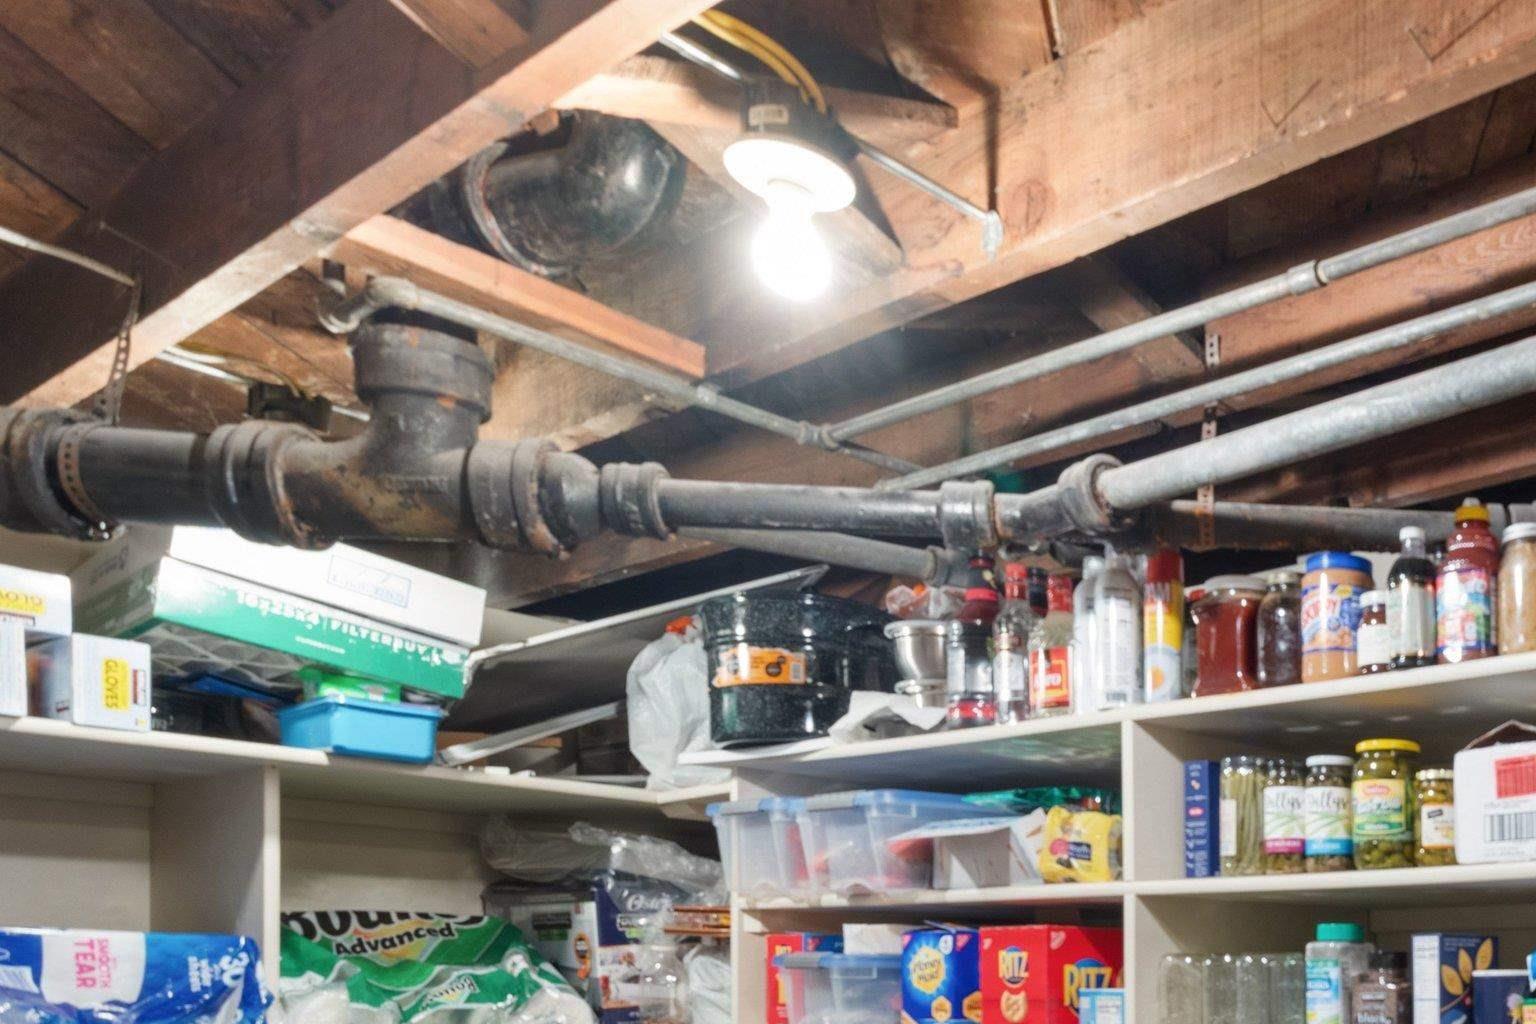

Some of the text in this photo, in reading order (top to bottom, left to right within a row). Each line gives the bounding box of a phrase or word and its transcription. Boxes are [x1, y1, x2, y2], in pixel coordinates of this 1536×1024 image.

[105, 658, 119, 710] GLOVES
[335, 922, 455, 958] Advanced
[75, 938, 96, 989] TEAR
[998, 949, 1030, 978] RITZ
